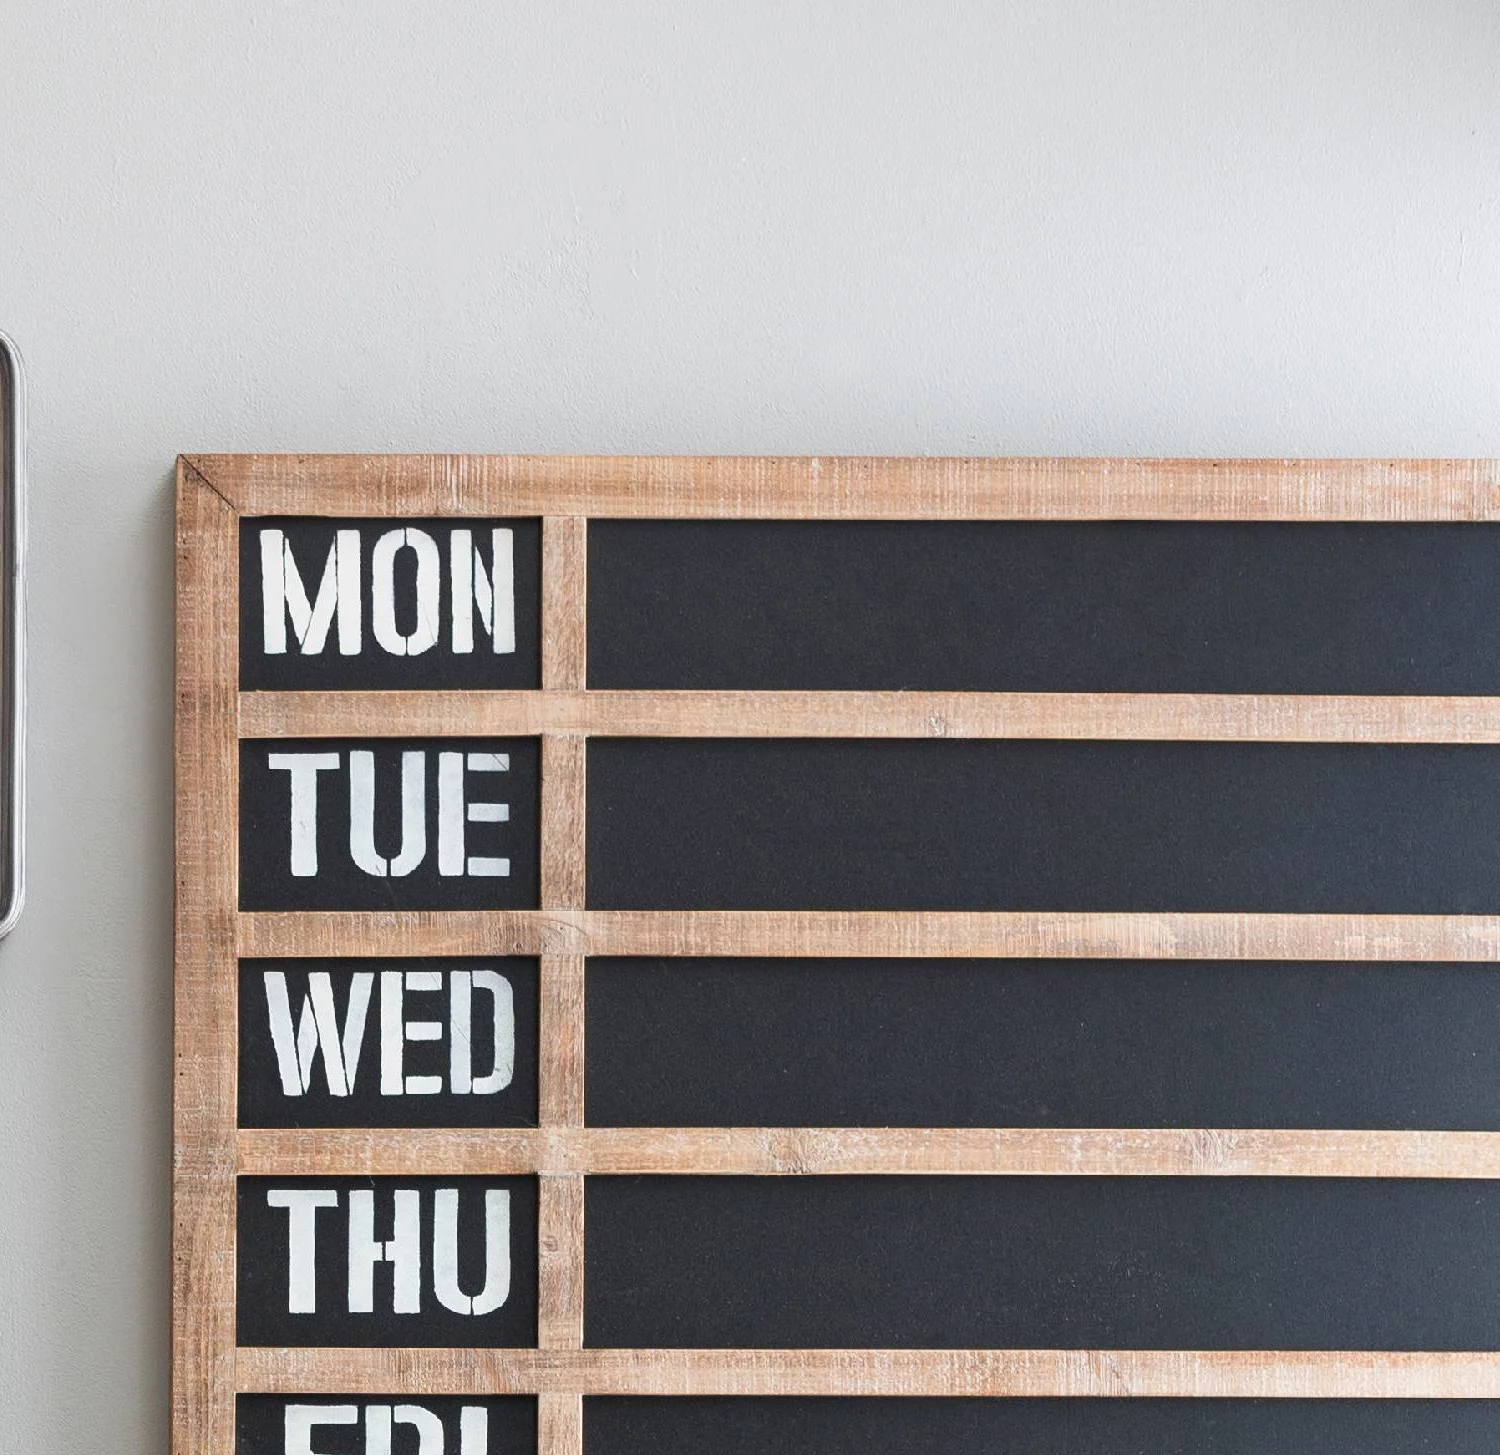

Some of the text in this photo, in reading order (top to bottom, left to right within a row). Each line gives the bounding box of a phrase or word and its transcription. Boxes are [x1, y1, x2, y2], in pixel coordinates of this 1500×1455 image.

[260, 528, 515, 656] MON
[269, 751, 509, 876] TUE
[264, 971, 514, 1097] WED
[267, 1189, 510, 1315] THU
